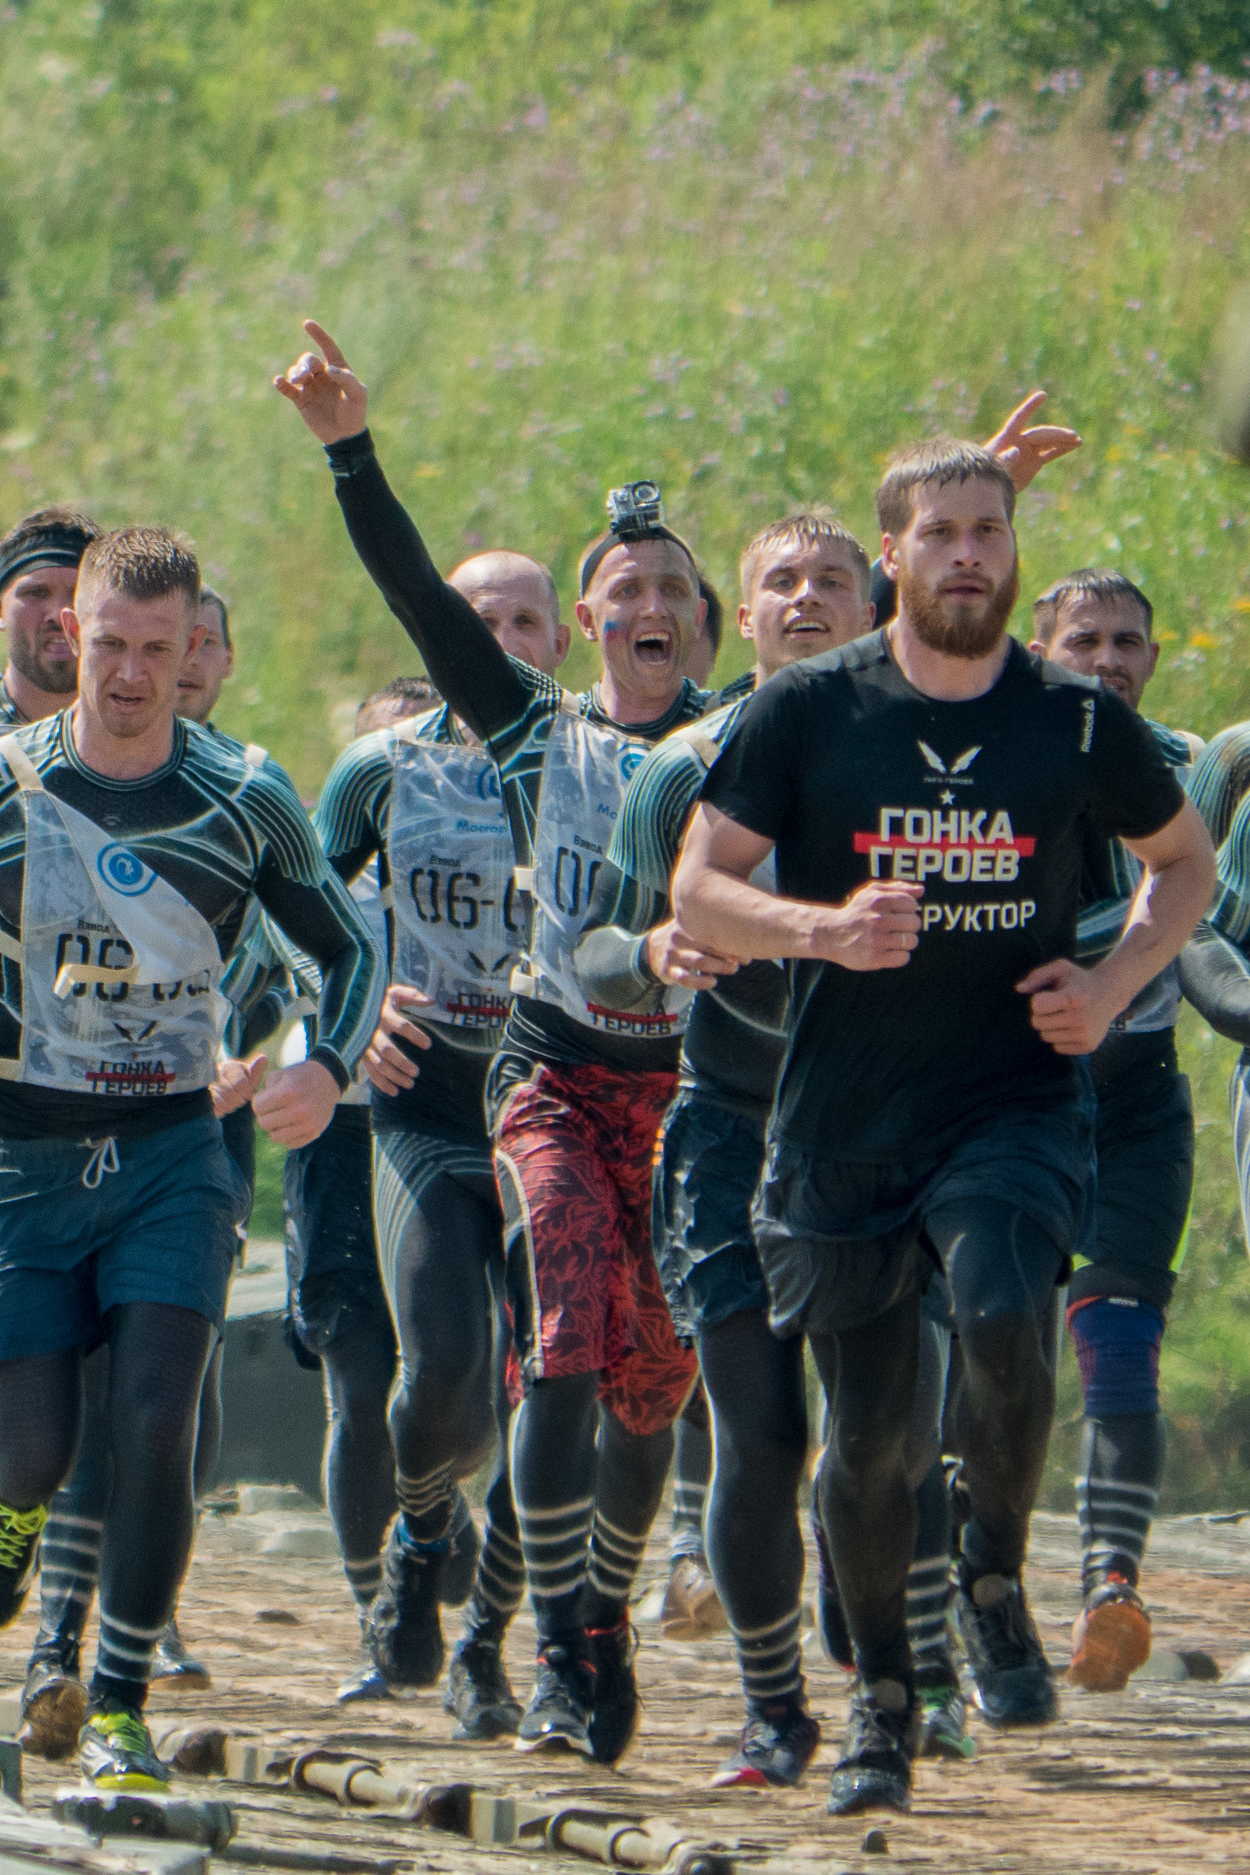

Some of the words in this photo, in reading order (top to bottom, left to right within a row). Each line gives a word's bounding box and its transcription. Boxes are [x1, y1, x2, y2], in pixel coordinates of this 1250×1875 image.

[1081, 711, 1094, 752] Reebok
[880, 807, 1015, 844] ГОНКА
[870, 846, 1020, 882] ГЕРОЕВ
[100, 1060, 166, 1075] ГОНКА
